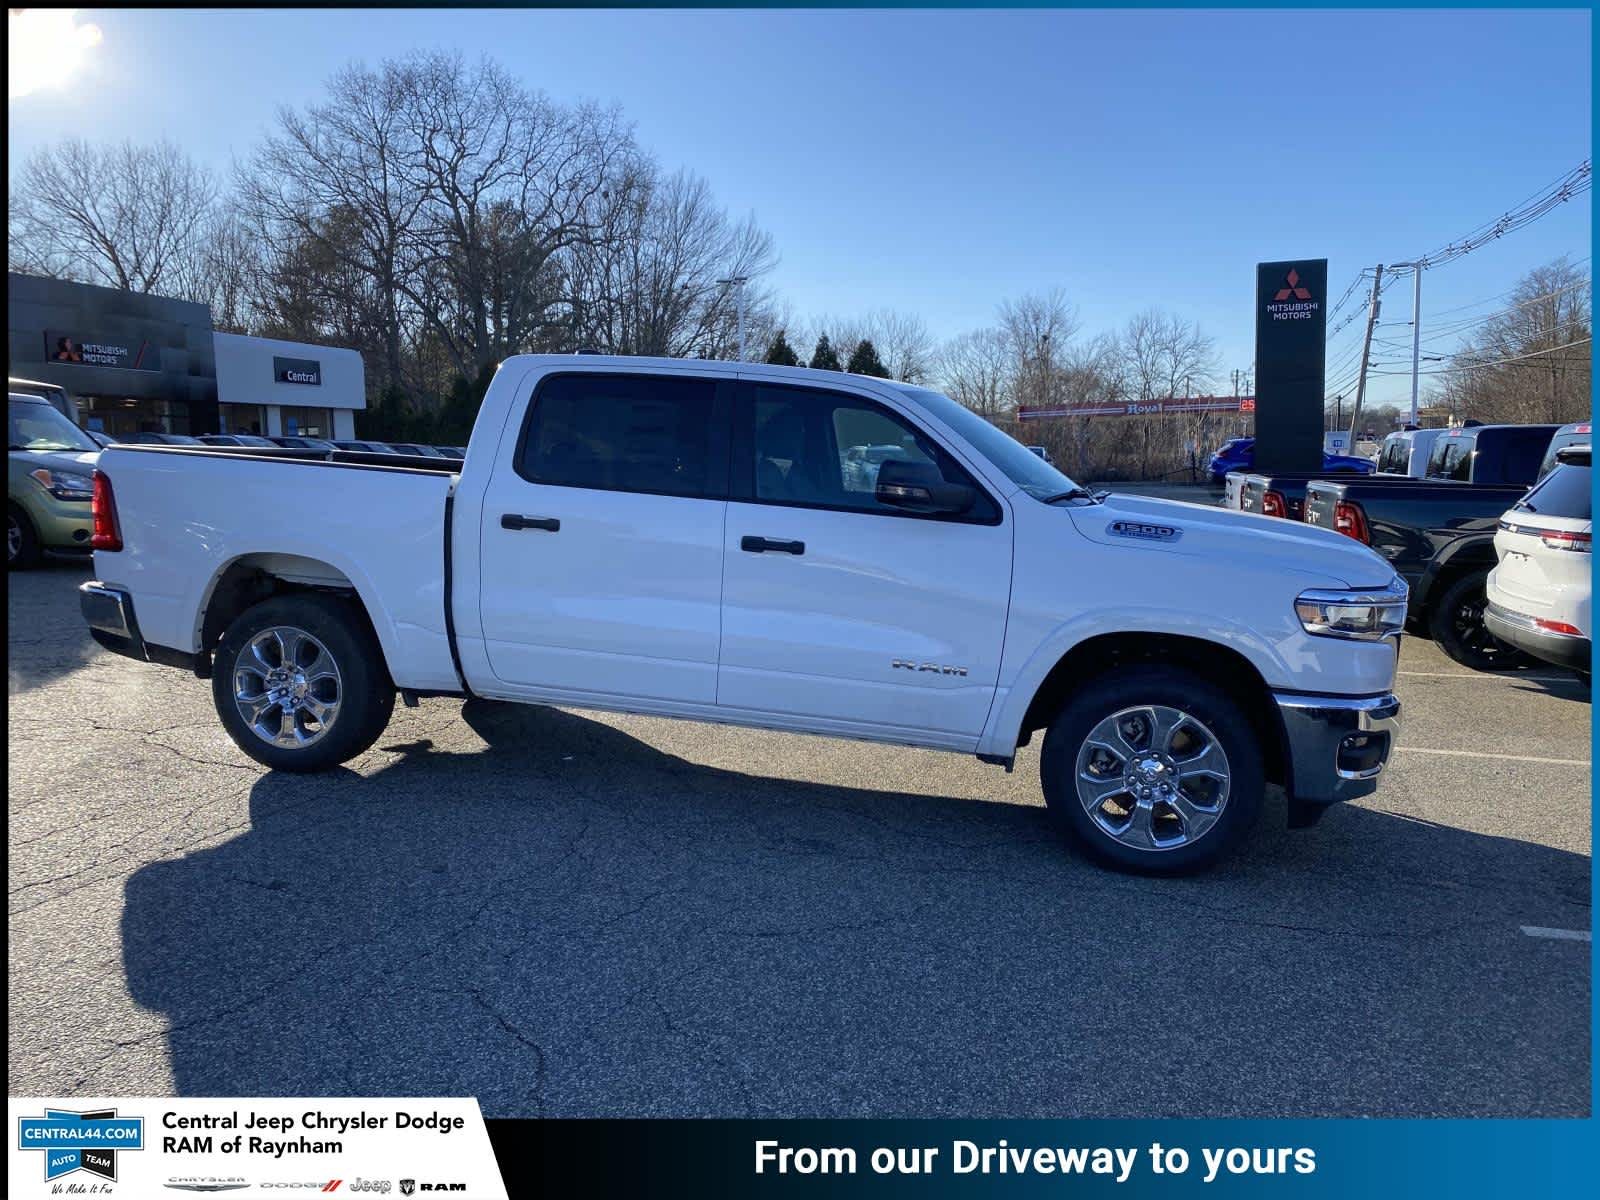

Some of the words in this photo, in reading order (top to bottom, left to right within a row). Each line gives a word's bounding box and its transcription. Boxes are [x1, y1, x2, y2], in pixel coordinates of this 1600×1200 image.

[1266, 303, 1319, 312] MITSUBISHI
[1273, 311, 1312, 321] MOTORS
[82, 343, 128, 356] MITSUBISHI
[82, 353, 118, 365] MOTORS
[287, 370, 318, 383] Central
[1127, 402, 1163, 415] Royal
[1119, 523, 1174, 537] 1500
[892, 658, 968, 677] RAM
